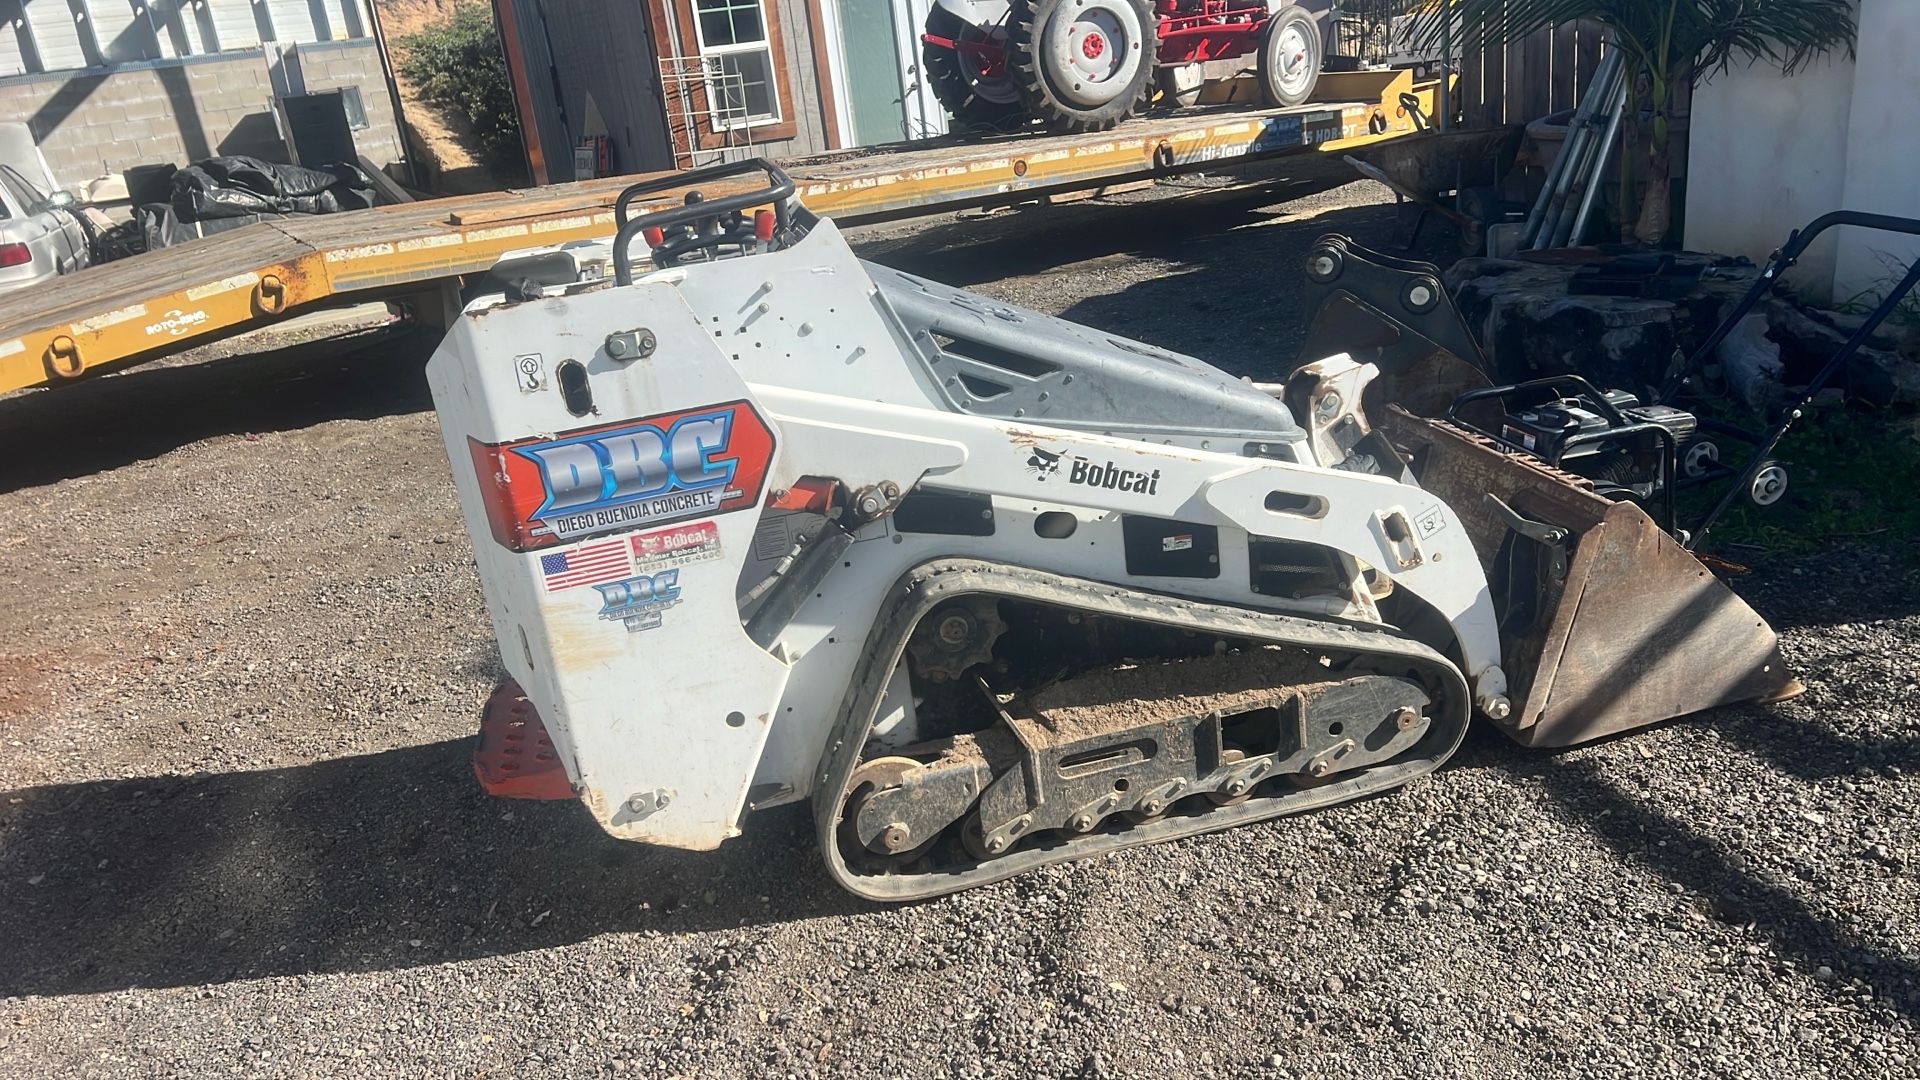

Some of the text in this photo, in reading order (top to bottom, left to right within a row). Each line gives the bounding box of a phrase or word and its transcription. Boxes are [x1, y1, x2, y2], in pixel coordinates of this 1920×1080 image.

[1202, 140, 1262, 161] Hi-Tensile
[518, 410, 739, 516] DBC
[1069, 456, 1161, 495] Bobcat
[557, 490, 715, 533] DIEGO BUENDIA CONCRETE
[663, 529, 707, 549] Bobcat
[593, 569, 681, 613] DBC
